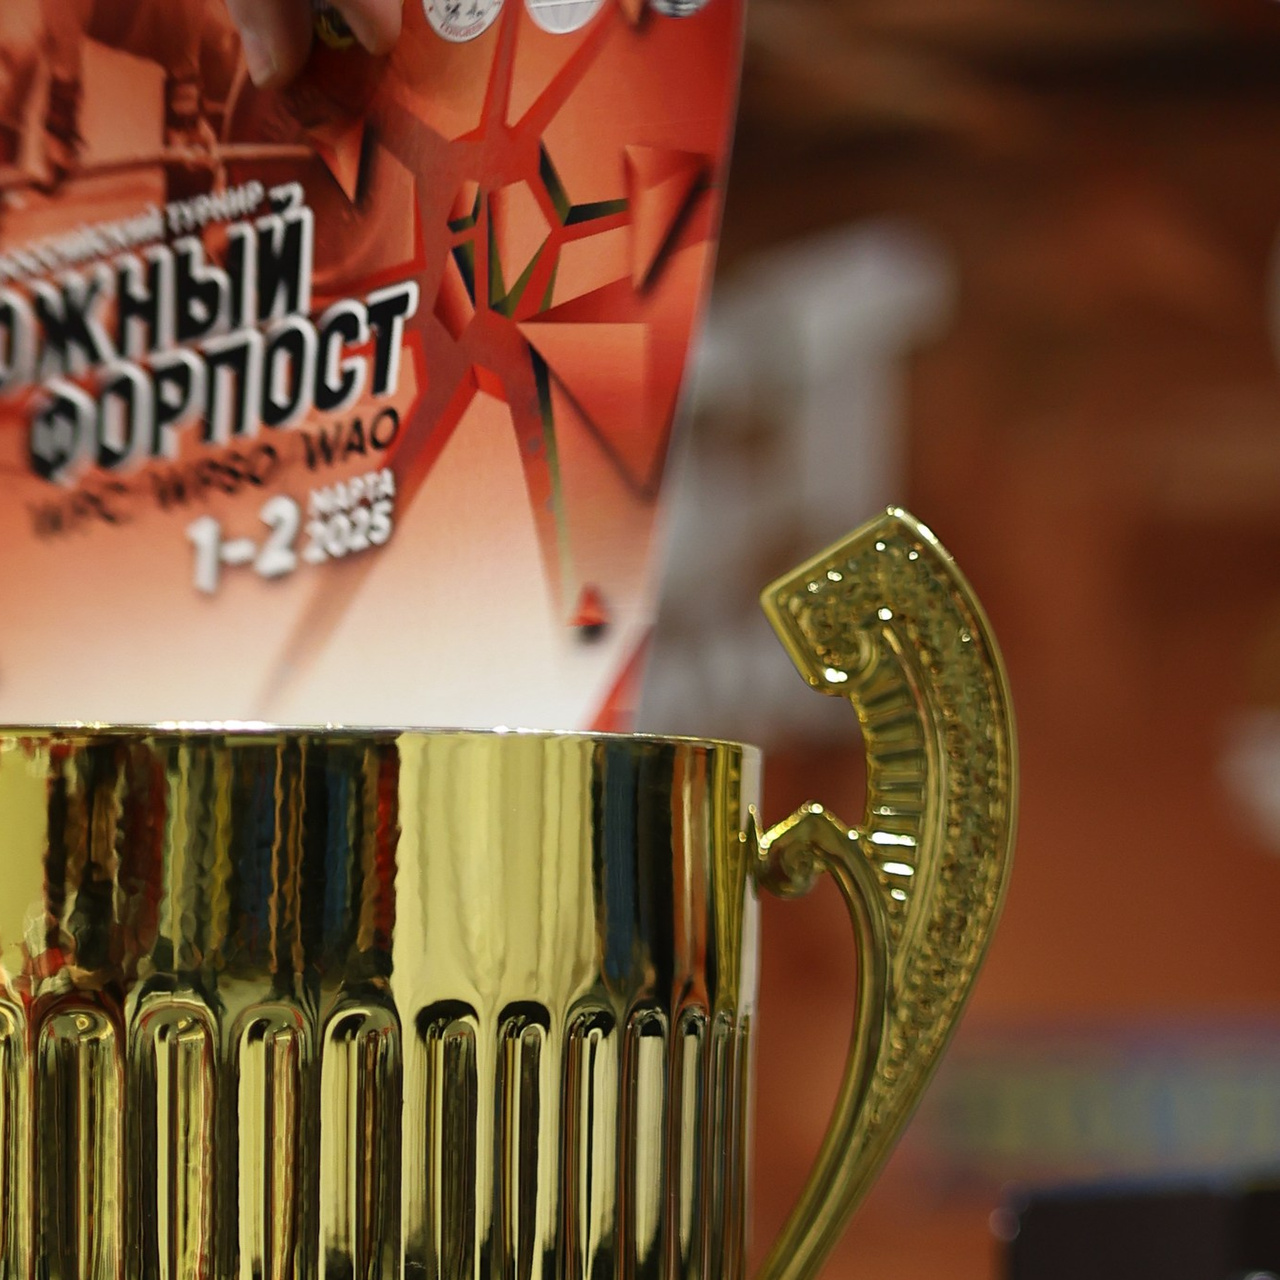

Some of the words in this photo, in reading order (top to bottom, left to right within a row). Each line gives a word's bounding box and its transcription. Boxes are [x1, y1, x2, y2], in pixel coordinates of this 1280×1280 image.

[28, 280, 419, 486] ФОРПОСТ
[299, 407, 400, 471] WAO
[184, 494, 300, 593] 1-2
[308, 467, 396, 518] МАРТА
[301, 500, 393, 564] 2025
